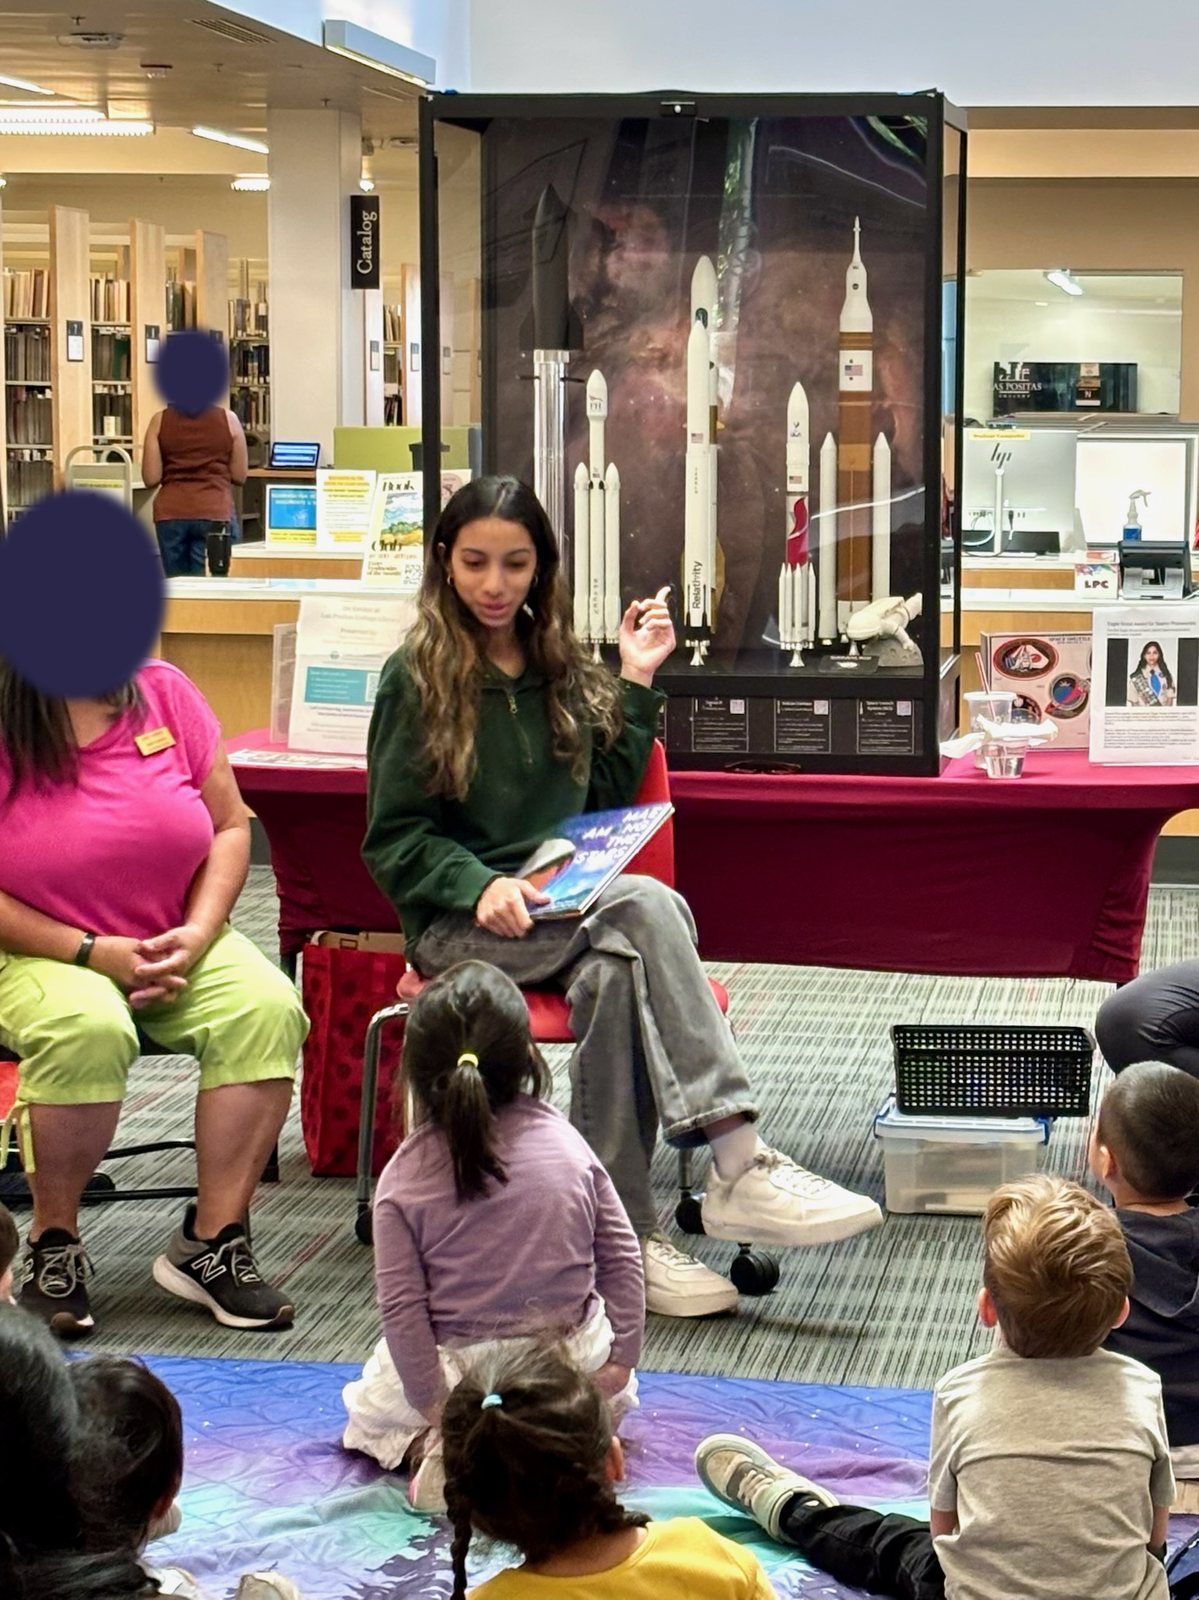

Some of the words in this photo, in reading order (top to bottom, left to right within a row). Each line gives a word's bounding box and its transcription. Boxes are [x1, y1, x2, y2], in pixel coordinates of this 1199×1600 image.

[356, 209, 378, 275] Catalog
[1005, 382, 1043, 391] POSITAS
[991, 442, 1012, 469] hp
[692, 560, 703, 609] Relativity
[1084, 580, 1109, 589] LPC
